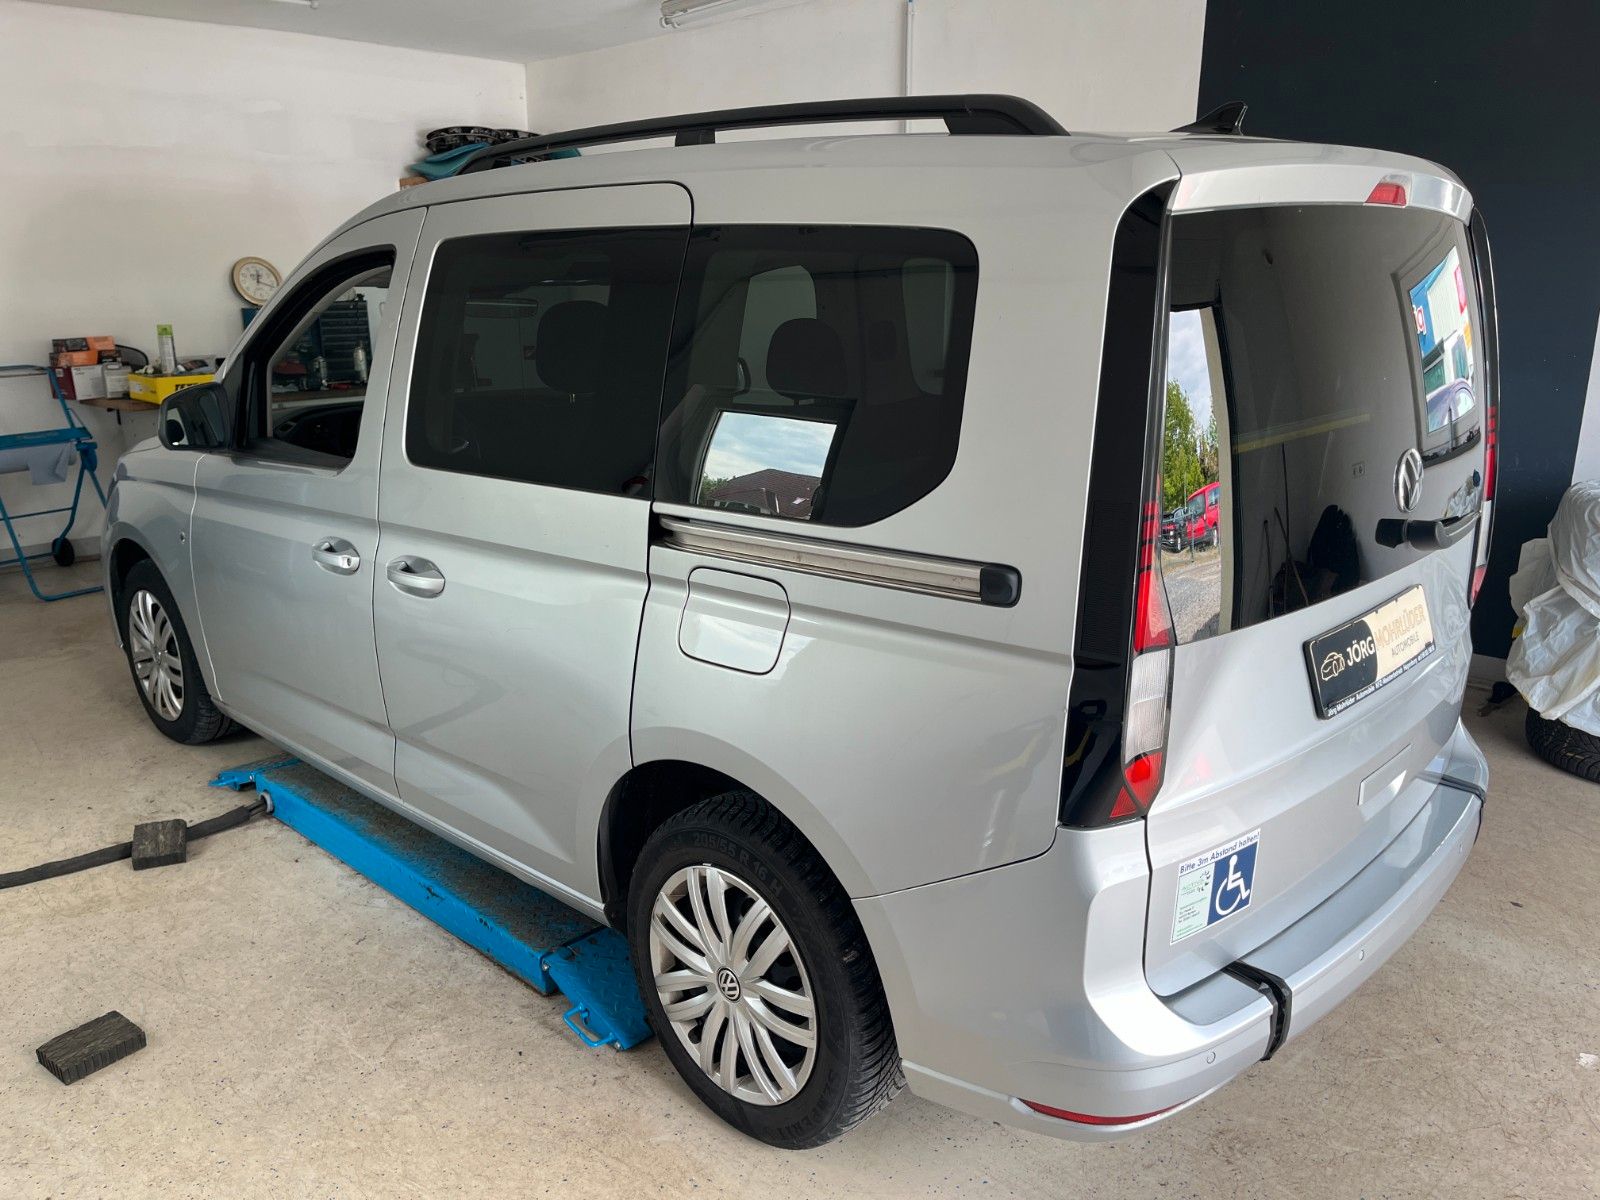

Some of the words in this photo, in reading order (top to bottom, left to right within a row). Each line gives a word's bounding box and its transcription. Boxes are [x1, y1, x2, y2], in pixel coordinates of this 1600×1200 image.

[1346, 635, 1376, 667] JÖRG
[1375, 603, 1426, 649] MOHRLÜDER
[1390, 631, 1420, 657] AUTOMOBILE
[694, 832, 737, 858] 205/55
[739, 848, 751, 865] R
[753, 861, 768, 881] 16
[1180, 860, 1196, 875] Bitte
[1197, 856, 1209, 868] 3m
[1210, 842, 1238, 862] Abstand
[1238, 831, 1260, 848] halten!
